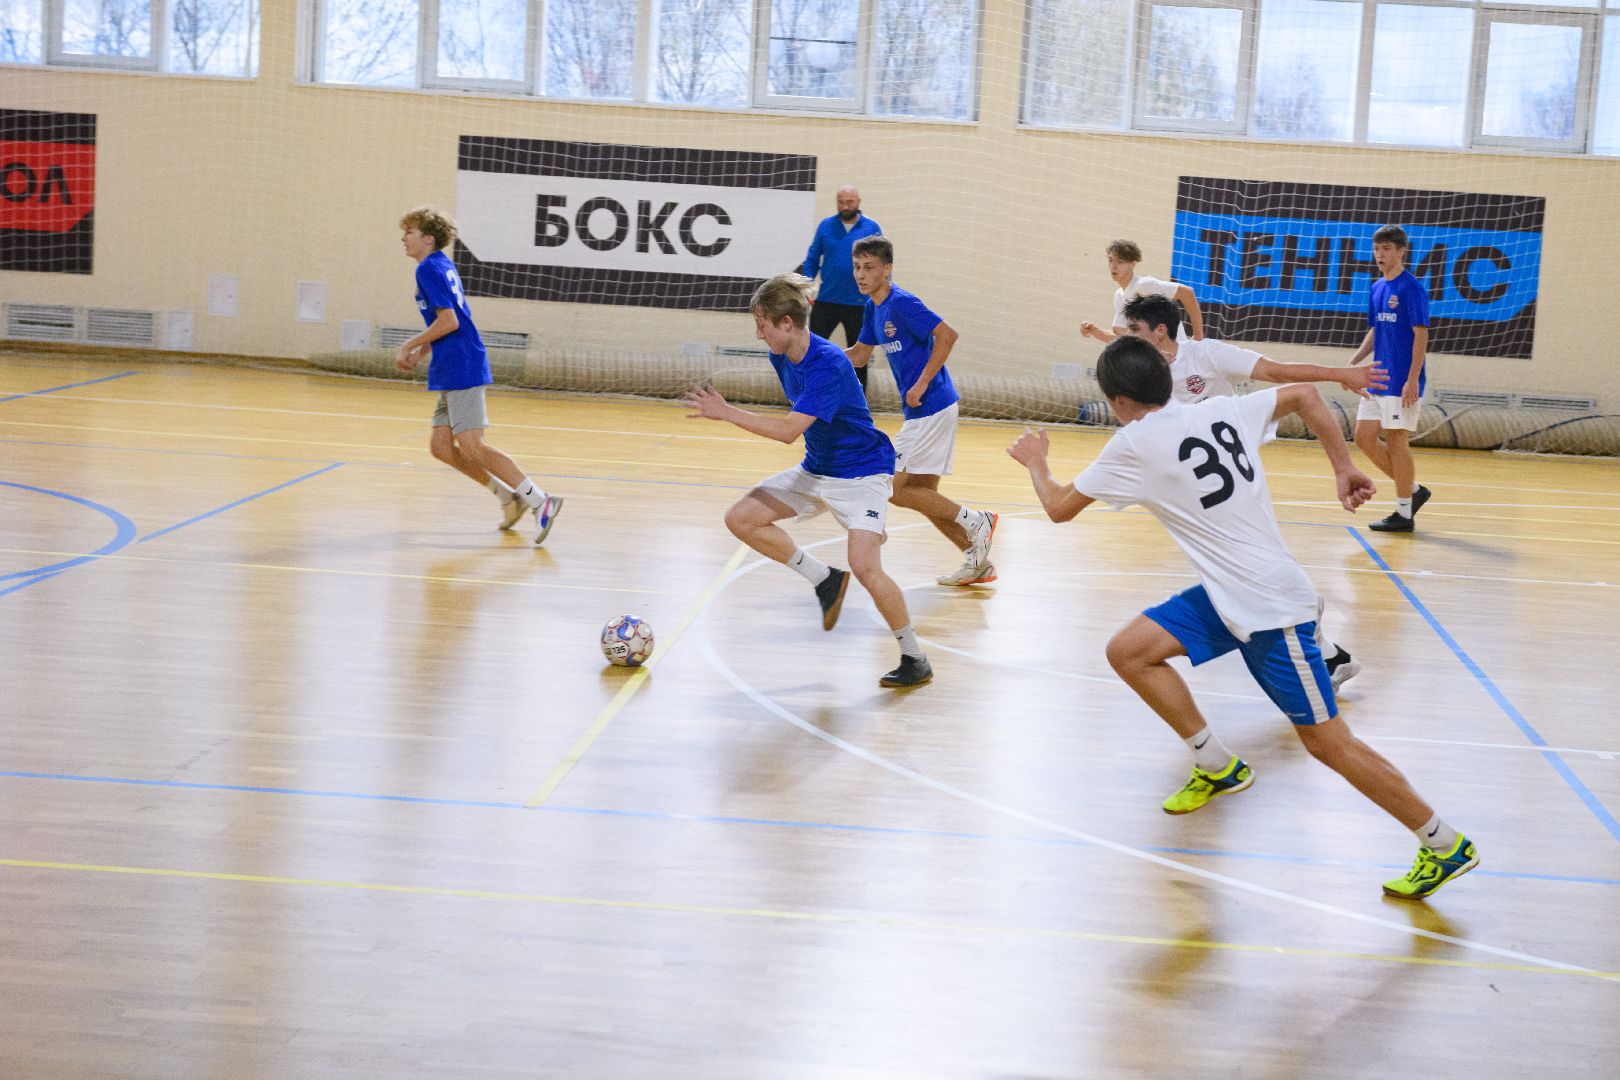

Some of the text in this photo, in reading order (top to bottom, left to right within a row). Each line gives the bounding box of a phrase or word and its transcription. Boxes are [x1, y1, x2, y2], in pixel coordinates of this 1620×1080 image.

[534, 194, 733, 258] БОКС
[1201, 229, 1512, 305] ТЕННИС
[1178, 421, 1255, 510] 38
